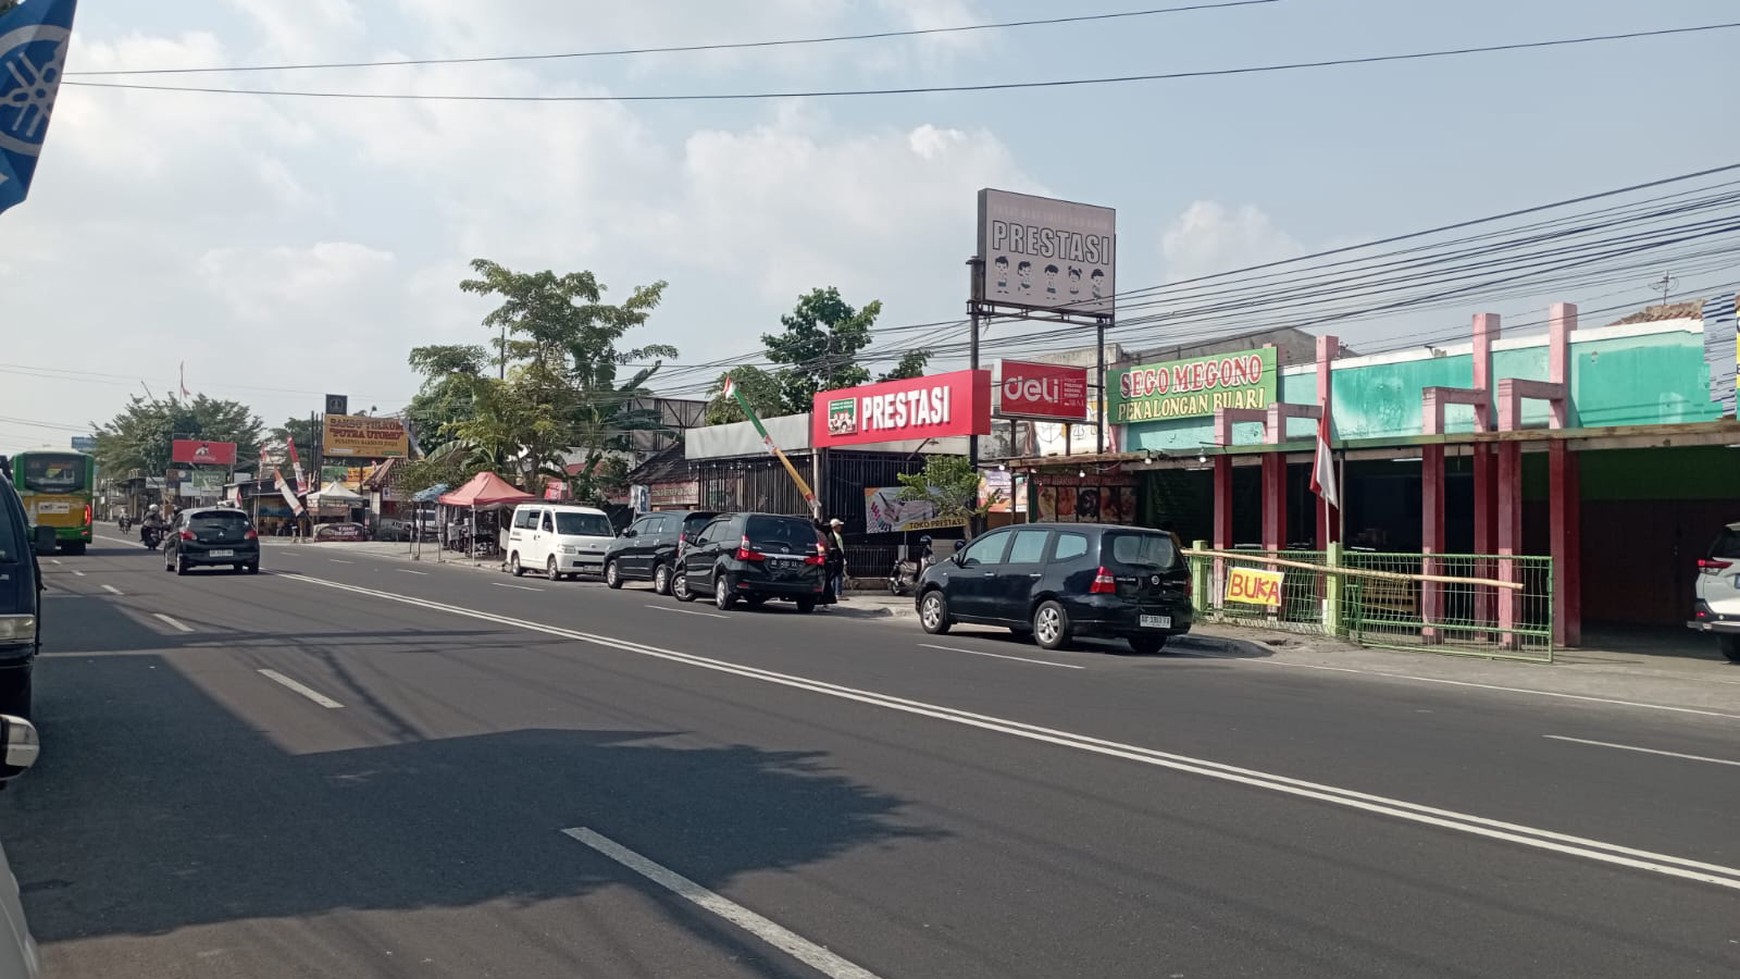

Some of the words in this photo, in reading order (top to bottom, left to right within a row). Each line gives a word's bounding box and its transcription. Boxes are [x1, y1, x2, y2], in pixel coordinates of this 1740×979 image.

[992, 219, 1110, 266] PRESTASI
[1004, 376, 1059, 404] deli
[1120, 366, 1171, 399] SEGO
[1172, 353, 1264, 394] MEGONO
[862, 385, 951, 431] PRESTASI
[1118, 394, 1209, 421] PEKALONGAN
[909, 521, 930, 529] TOKO
[1230, 573, 1281, 604] BUKA
